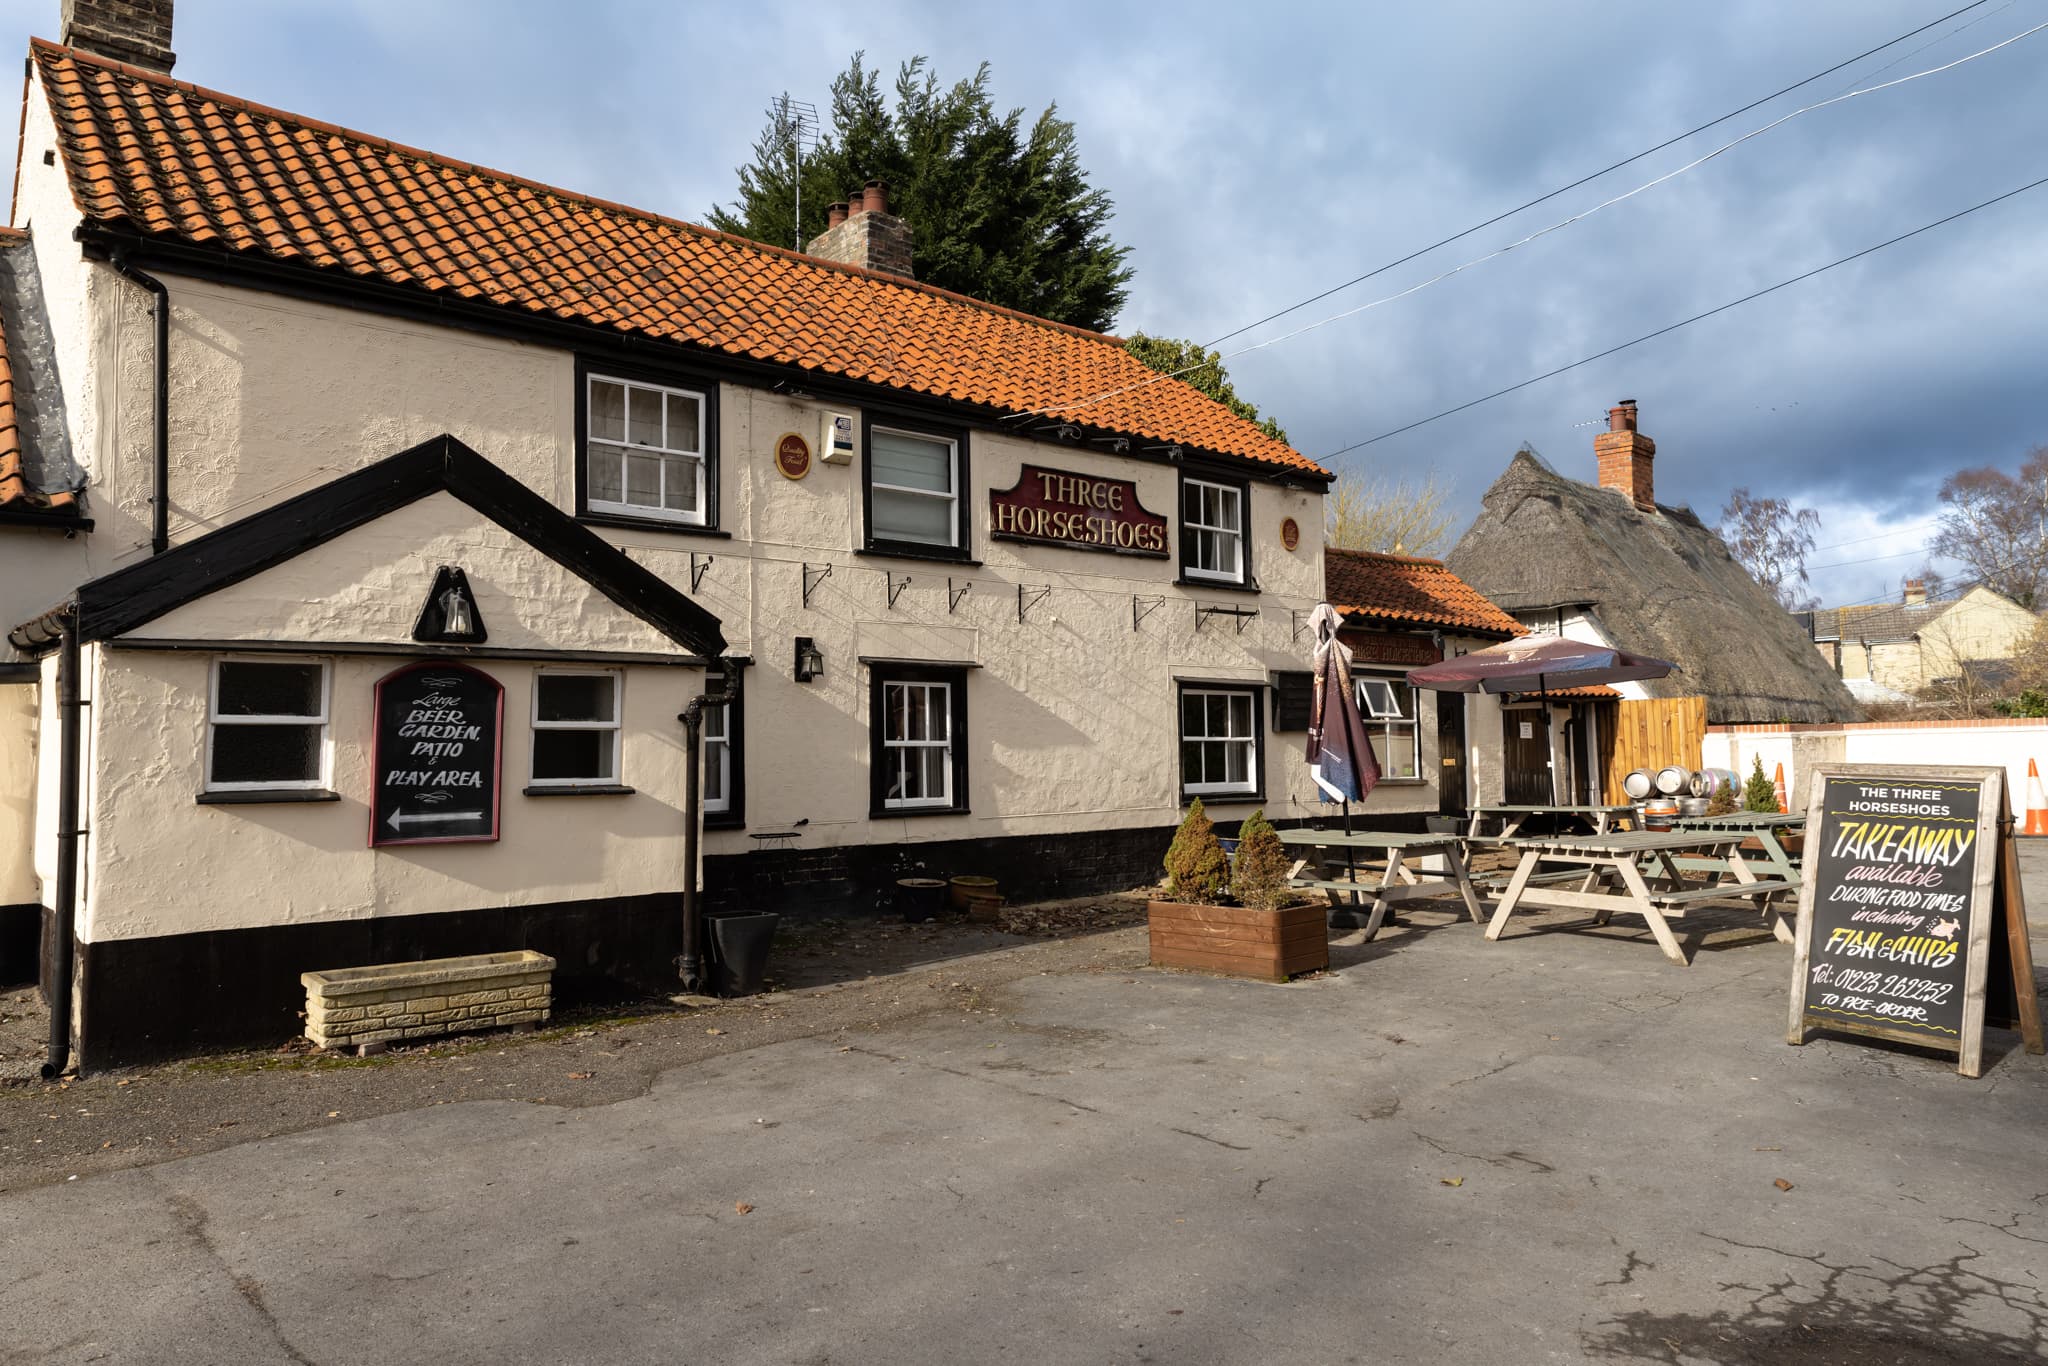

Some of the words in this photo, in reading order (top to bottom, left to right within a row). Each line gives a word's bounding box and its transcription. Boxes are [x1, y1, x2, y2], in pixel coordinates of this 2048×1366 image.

[1037, 472, 1124, 512] THREE
[996, 502, 1165, 551] HORSESHOES
[412, 691, 461, 711] Large
[405, 709, 467, 725] BEER
[398, 724, 481, 742] GARDEN,
[410, 741, 464, 758] PATIO
[428, 756, 437, 765] &
[385, 770, 433, 786] PLAY
[431, 770, 483, 789] AREA
[1859, 786, 1888, 799] THE
[1891, 788, 1942, 801] THREE
[1849, 800, 1951, 816] HORSESHOES
[1831, 821, 1975, 867] TAKEAWAY
[1845, 863, 1944, 888] available
[1828, 884, 1891, 906] DURING
[1888, 889, 1923, 909] FOOD
[1921, 891, 1966, 913] TIMES
[1851, 906, 1926, 932] including
[1824, 927, 1884, 958] FISH
[1877, 939, 1891, 958] &
[1887, 937, 1960, 969] CHIPS
[1811, 962, 1834, 985] Tel:
[1834, 967, 1884, 994] 01223
[1882, 974, 1954, 1005] 262252
[1820, 992, 1839, 1006] TO
[1839, 995, 1929, 1022] PRE-ORDER
